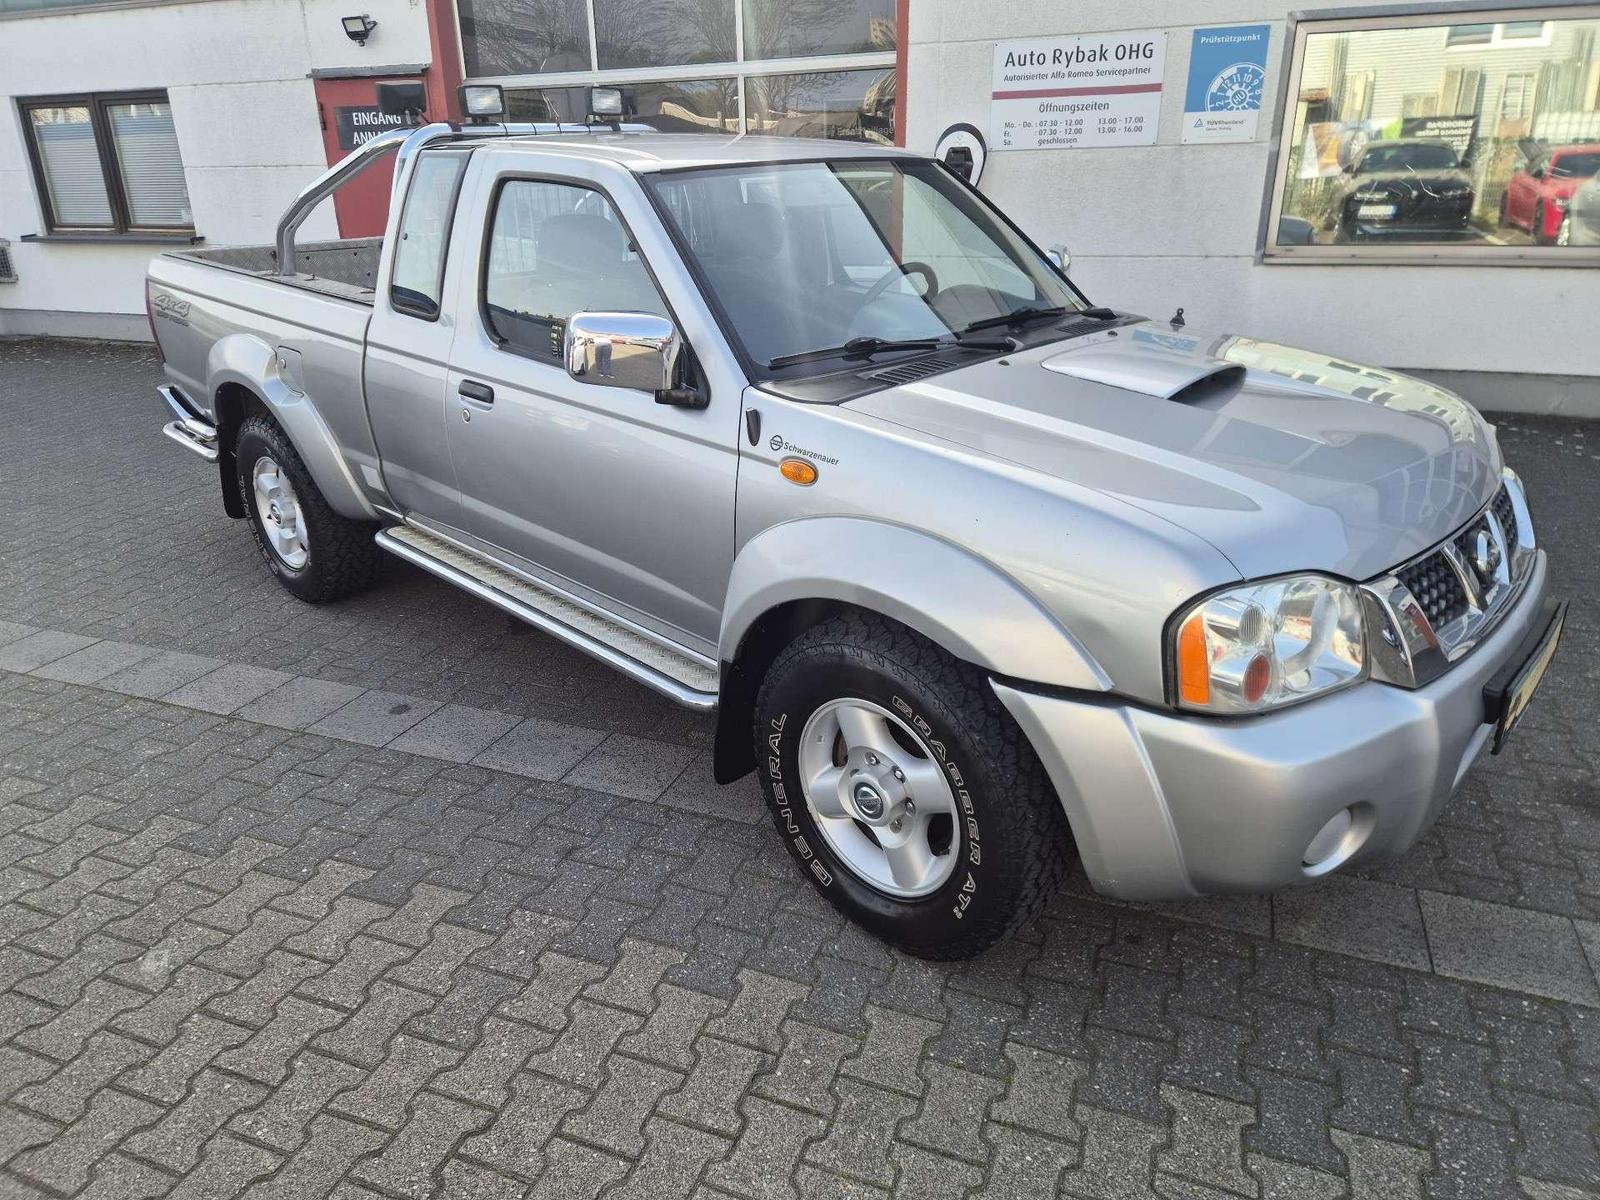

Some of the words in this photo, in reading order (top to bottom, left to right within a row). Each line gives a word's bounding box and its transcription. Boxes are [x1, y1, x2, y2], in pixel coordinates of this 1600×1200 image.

[1200, 33, 1261, 44] Prüfstützpunkt
[1004, 51, 1047, 68] Auto
[1052, 44, 1109, 69] Rybak
[1114, 42, 1154, 61] OHG
[1003, 72, 1049, 82] Autorisierter
[1050, 70, 1066, 80] Alfa
[1067, 69, 1094, 79] Romeo
[1095, 67, 1152, 77] Servicepartner
[1038, 101, 1110, 114] Öffnungszeiten
[352, 111, 402, 126] EINGANG
[1064, 118, 1084, 127] 12.00
[1124, 116, 1144, 124] 17.00
[1064, 127, 1083, 135] 12.00
[1097, 126, 1117, 134] 13.00
[1123, 125, 1143, 133] 16.00
[1037, 137, 1078, 146] geschlossen
[783, 441, 839, 466] Schwarzenauer
[892, 695, 982, 866] GRABBER
[768, 713, 833, 887] GENERAL
